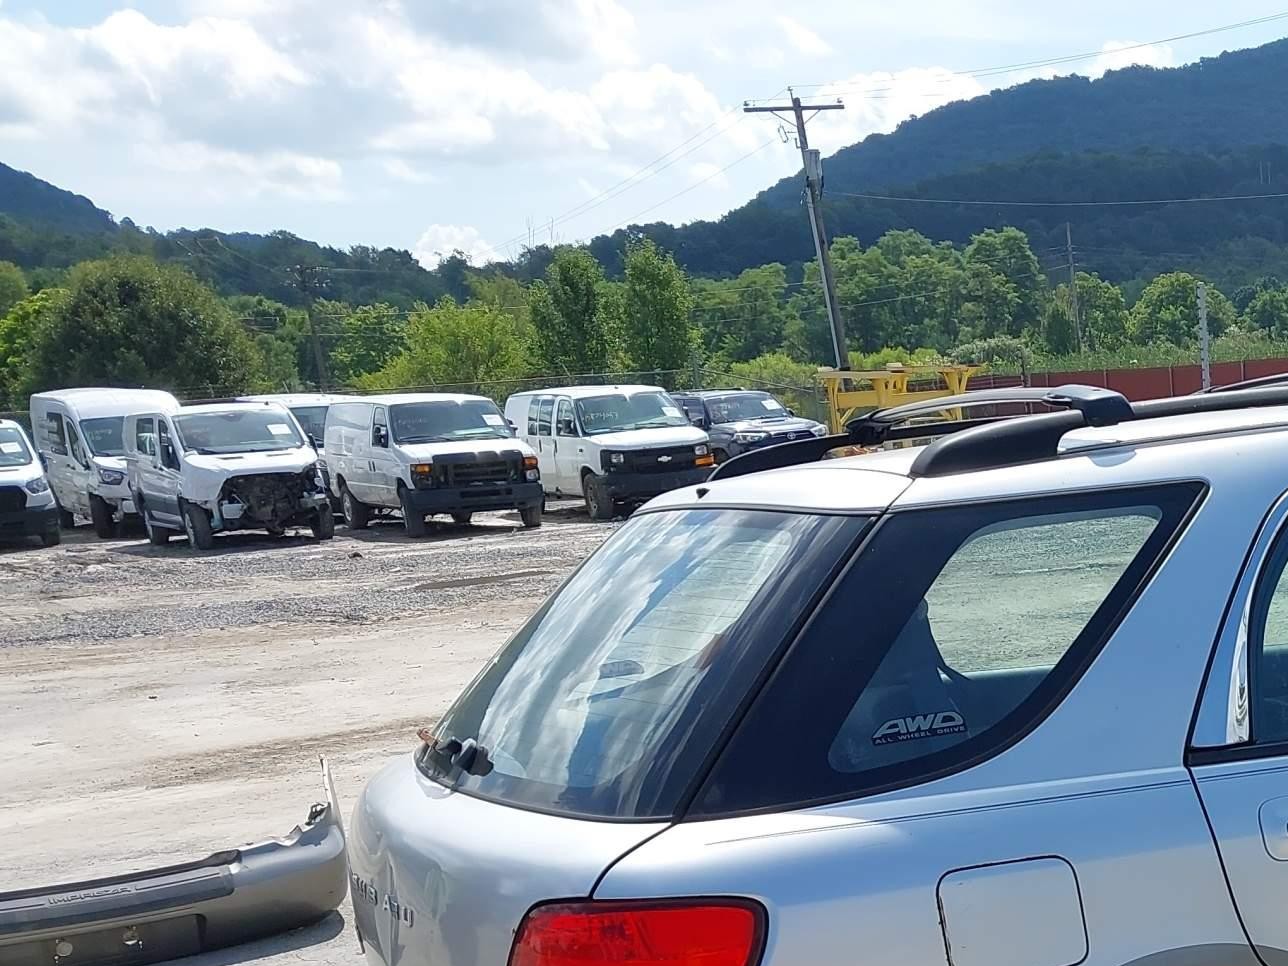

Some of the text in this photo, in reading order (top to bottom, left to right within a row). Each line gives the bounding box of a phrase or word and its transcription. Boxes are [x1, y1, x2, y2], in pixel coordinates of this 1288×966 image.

[872, 711, 964, 738] AWD
[875, 725, 966, 745] ALL WHEEL DRIVE
[352, 873, 414, 928] SUBARU
